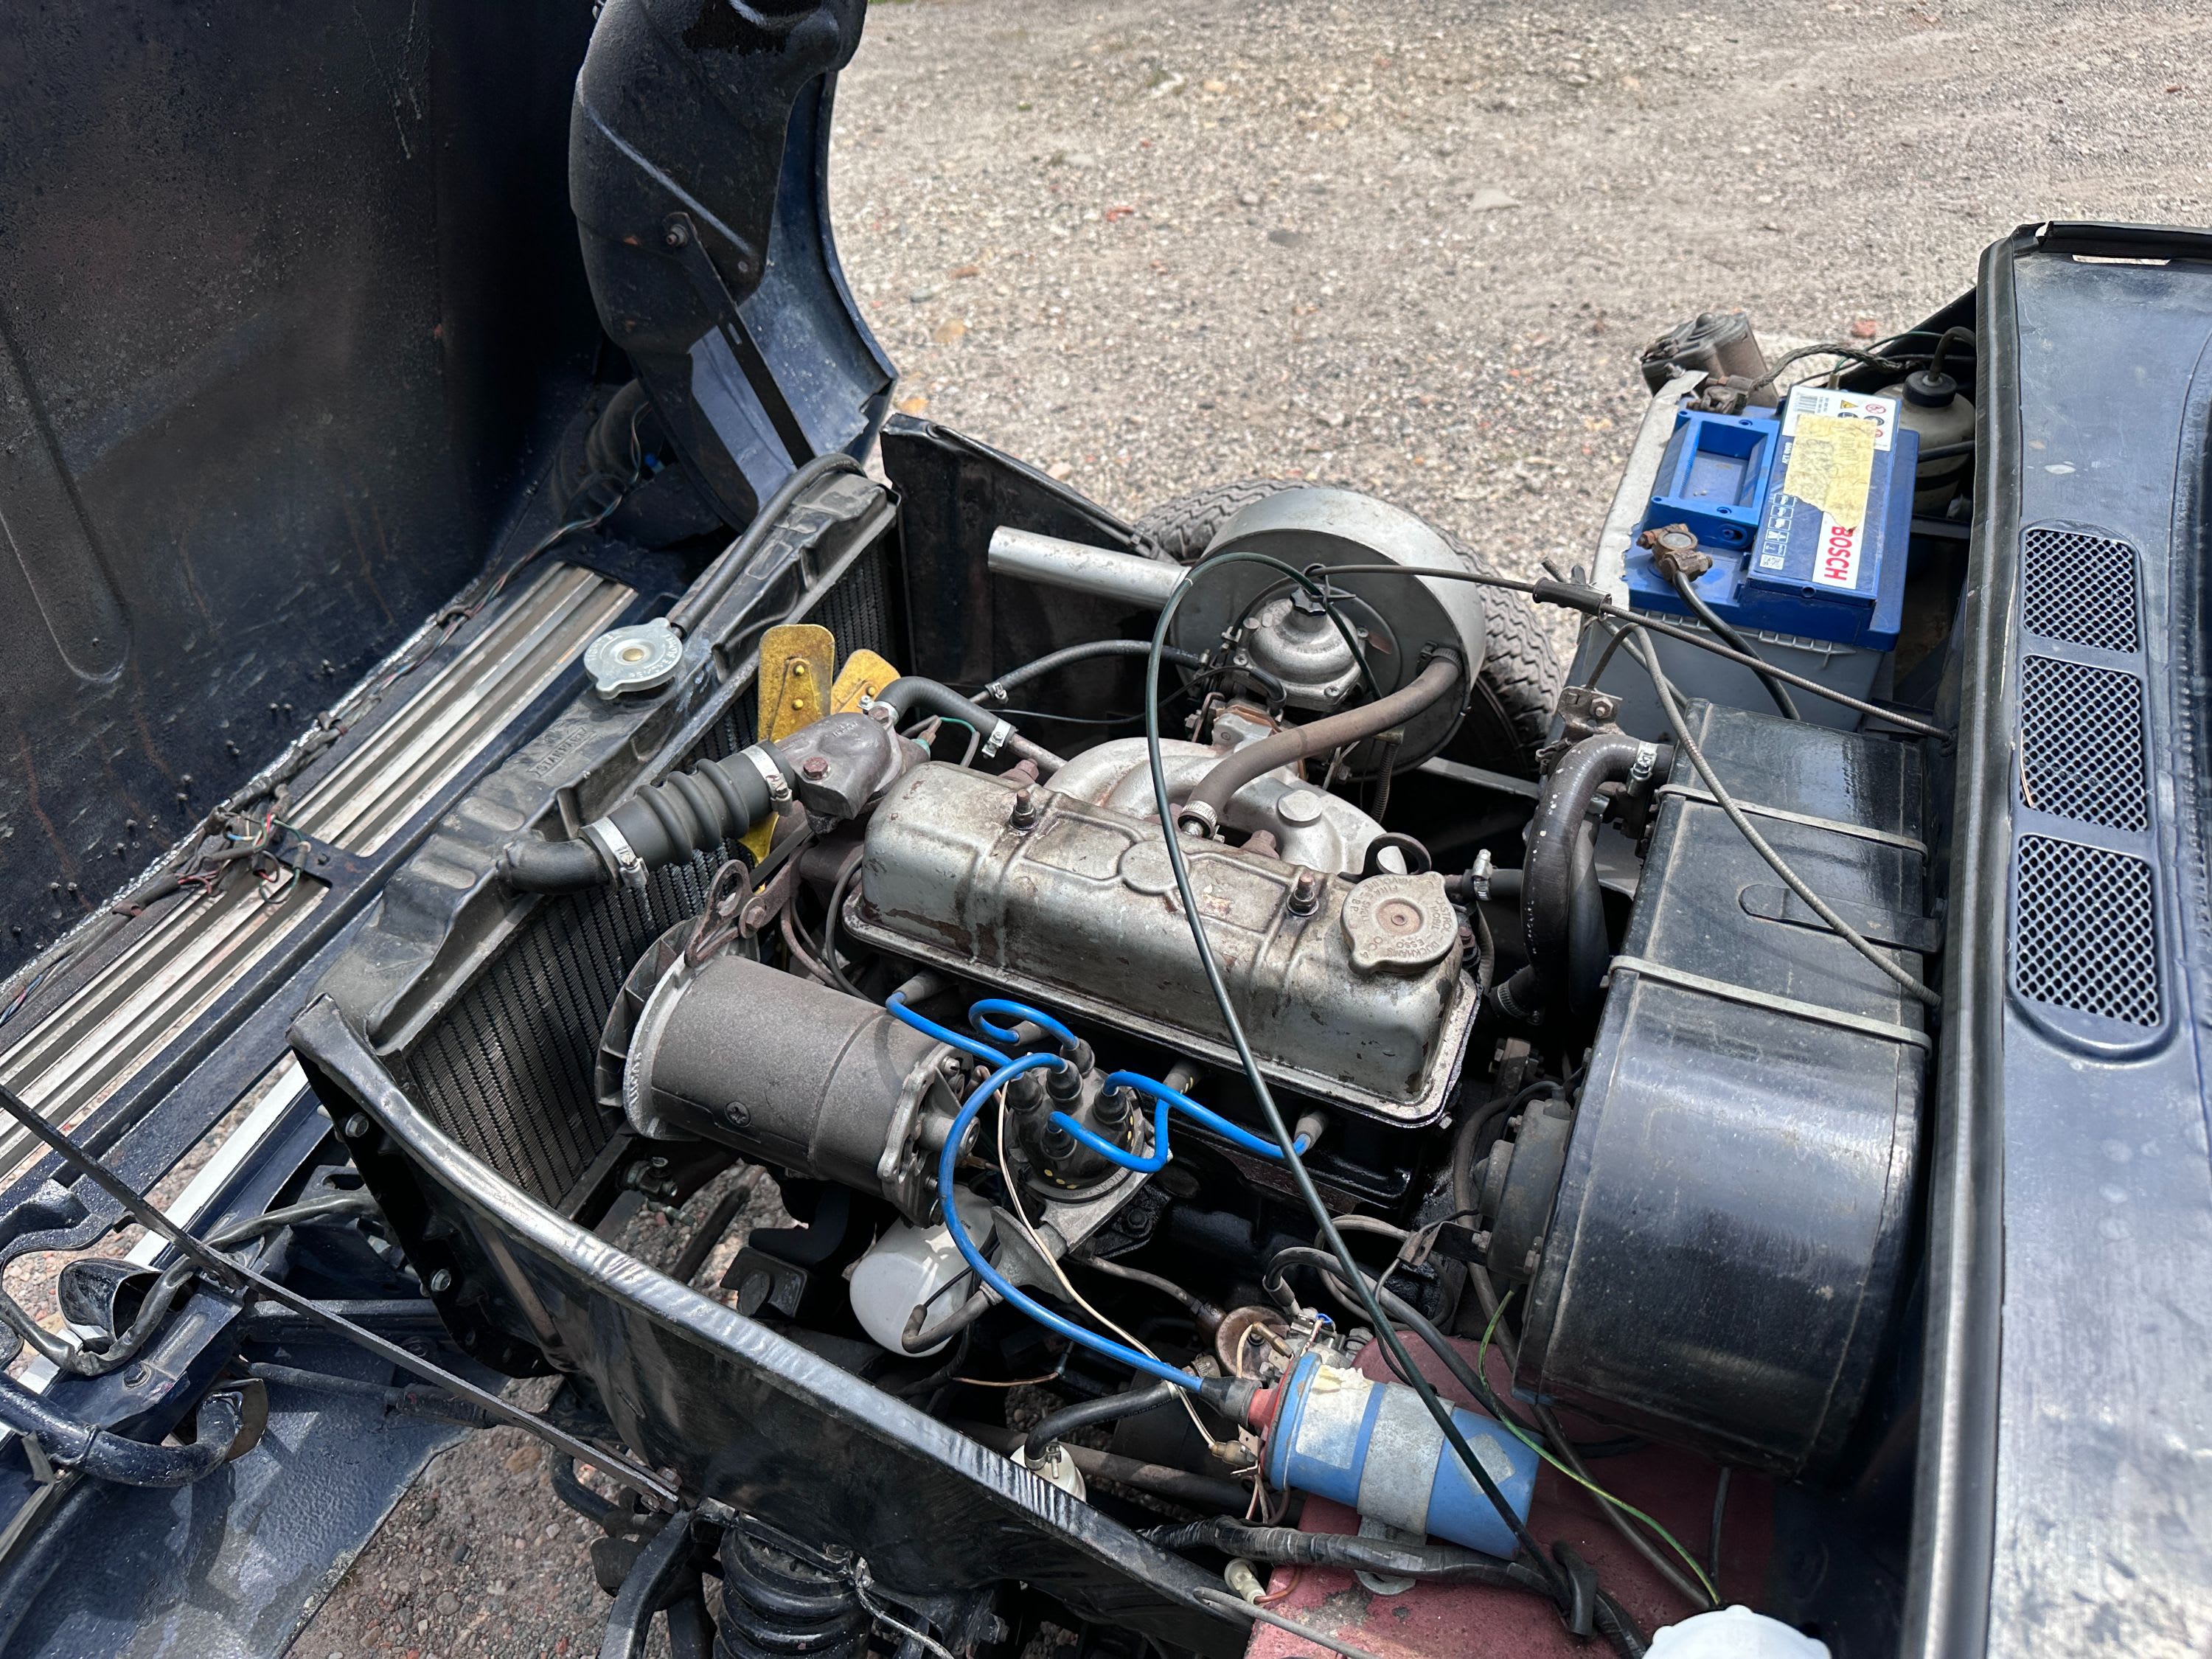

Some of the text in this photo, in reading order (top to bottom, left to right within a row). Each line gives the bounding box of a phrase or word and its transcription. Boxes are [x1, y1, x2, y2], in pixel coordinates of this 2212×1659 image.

[1824, 526, 1853, 580] BOSCH
[1396, 938, 1425, 949] ESSO
[1095, 1167, 1130, 1193] LUCAS
